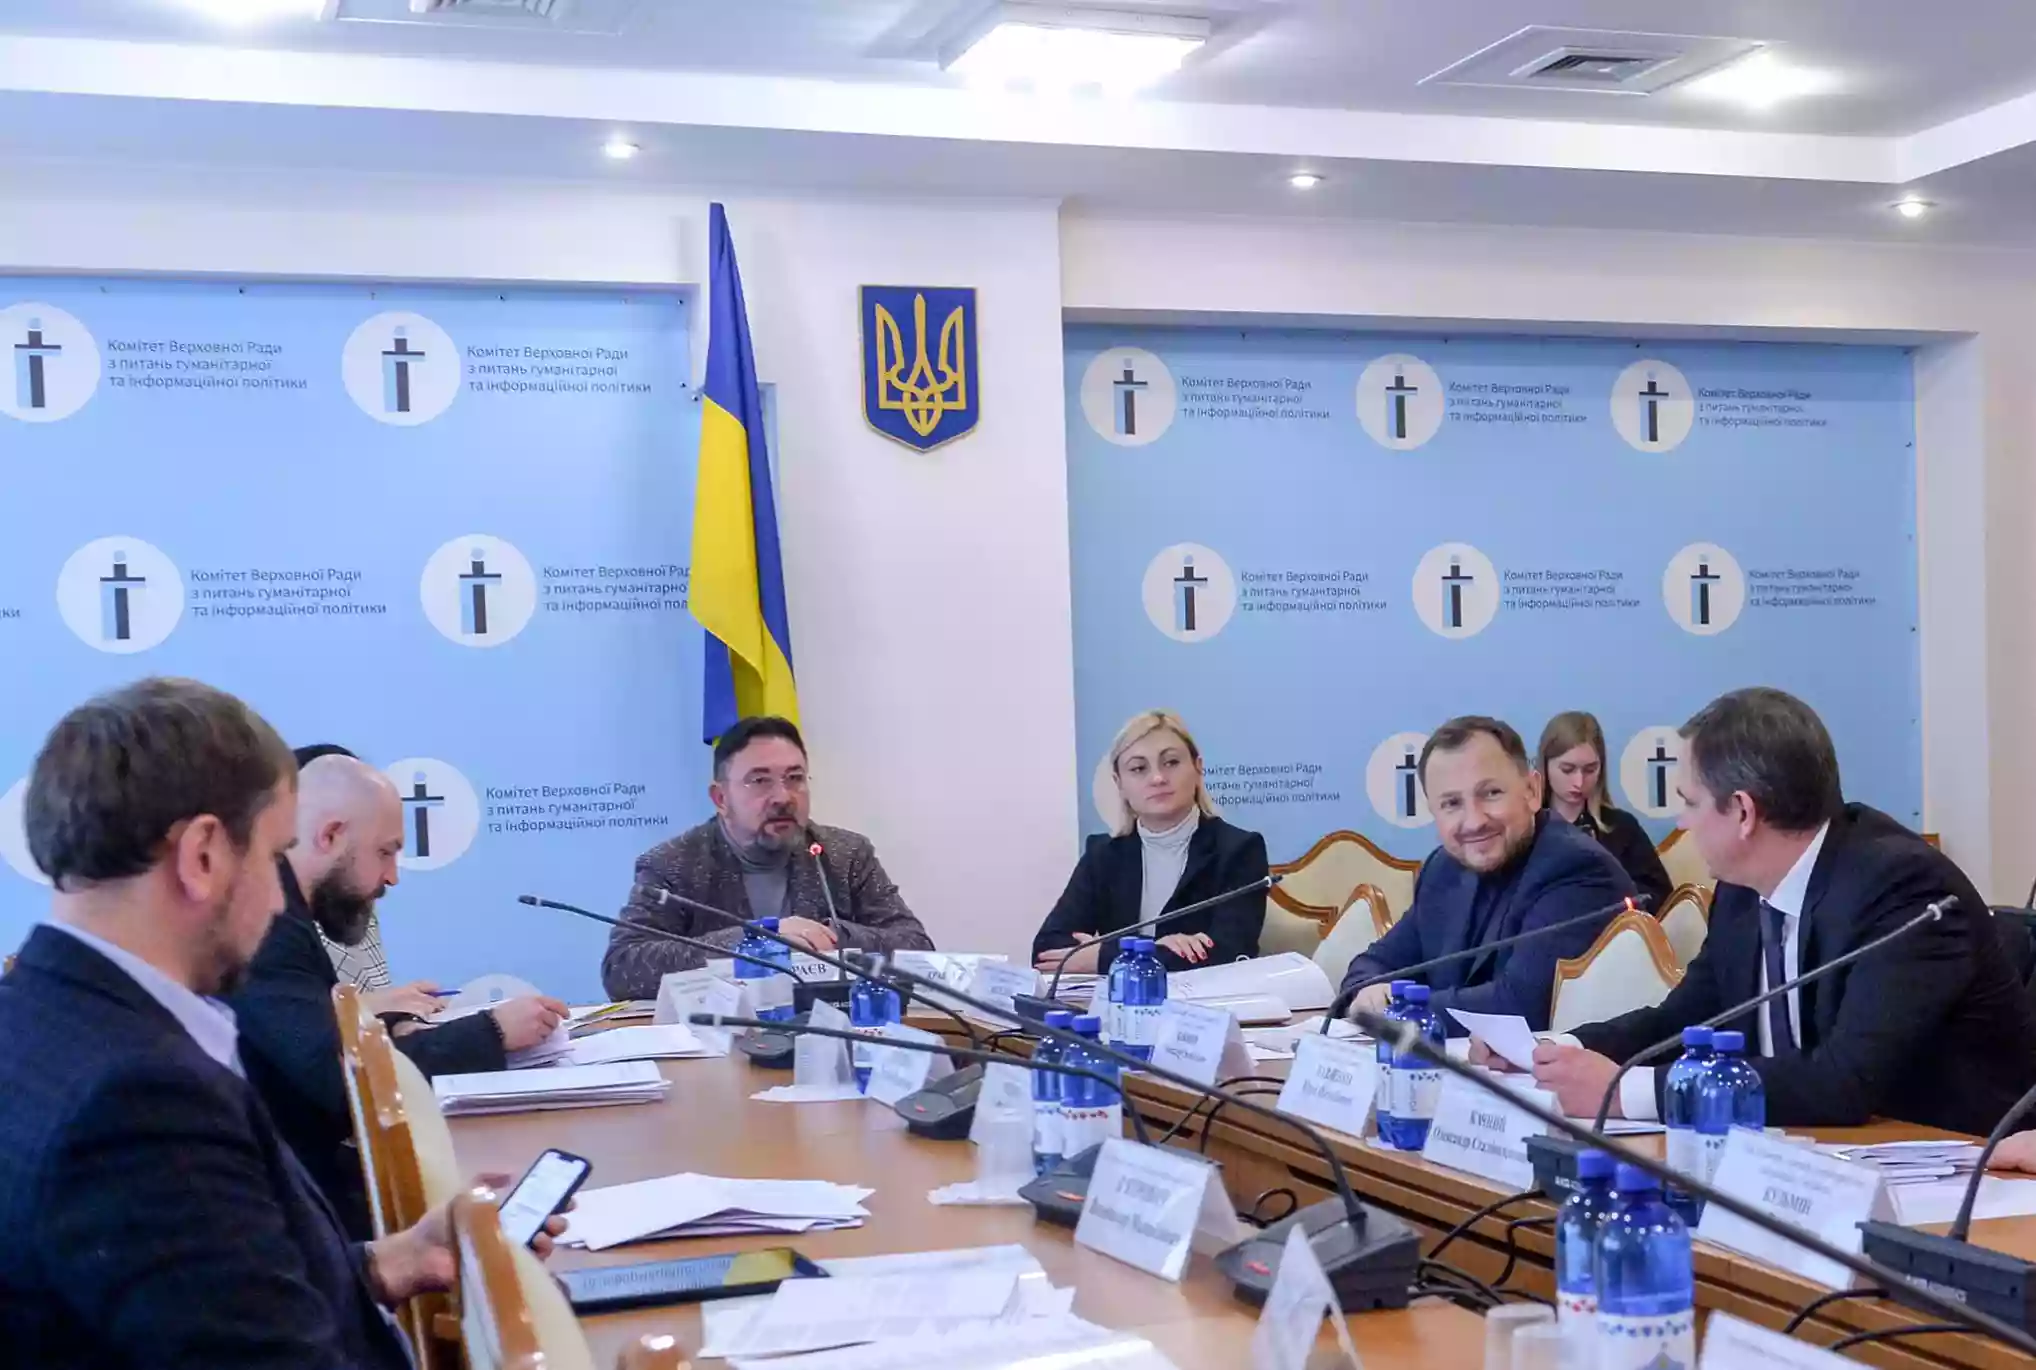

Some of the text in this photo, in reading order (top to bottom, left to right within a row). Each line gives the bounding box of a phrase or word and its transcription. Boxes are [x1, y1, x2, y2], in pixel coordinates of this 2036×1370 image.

[107, 340, 282, 355] Комітет Верховної Ради
[467, 346, 628, 361] Комітет Верховної Ради
[120, 359, 172, 370] питань
[177, 359, 271, 371] гуманітарної
[479, 364, 527, 375] питань
[531, 365, 618, 377] гуманітарної
[129, 375, 238, 390] інформаційної
[242, 377, 308, 389] політики
[487, 380, 588, 394] інформаційної
[591, 381, 651, 393] політики
[191, 568, 362, 583] Комітет Верховної Ради
[543, 567, 596, 578] Комітет
[599, 565, 666, 580] Верховної
[203, 588, 254, 599] питань
[258, 586, 350, 600] гуманітарної
[554, 585, 602, 595] питань
[605, 582, 688, 596] гуманітарно
[192, 603, 386, 619] та інформаційної політики
[563, 598, 661, 613] інформаційної
[486, 783, 645, 799] Комітет Верховної Ради
[497, 804, 545, 815] питань
[549, 799, 635, 816] гуманітарної
[489, 815, 668, 833] та інформаційної політики
